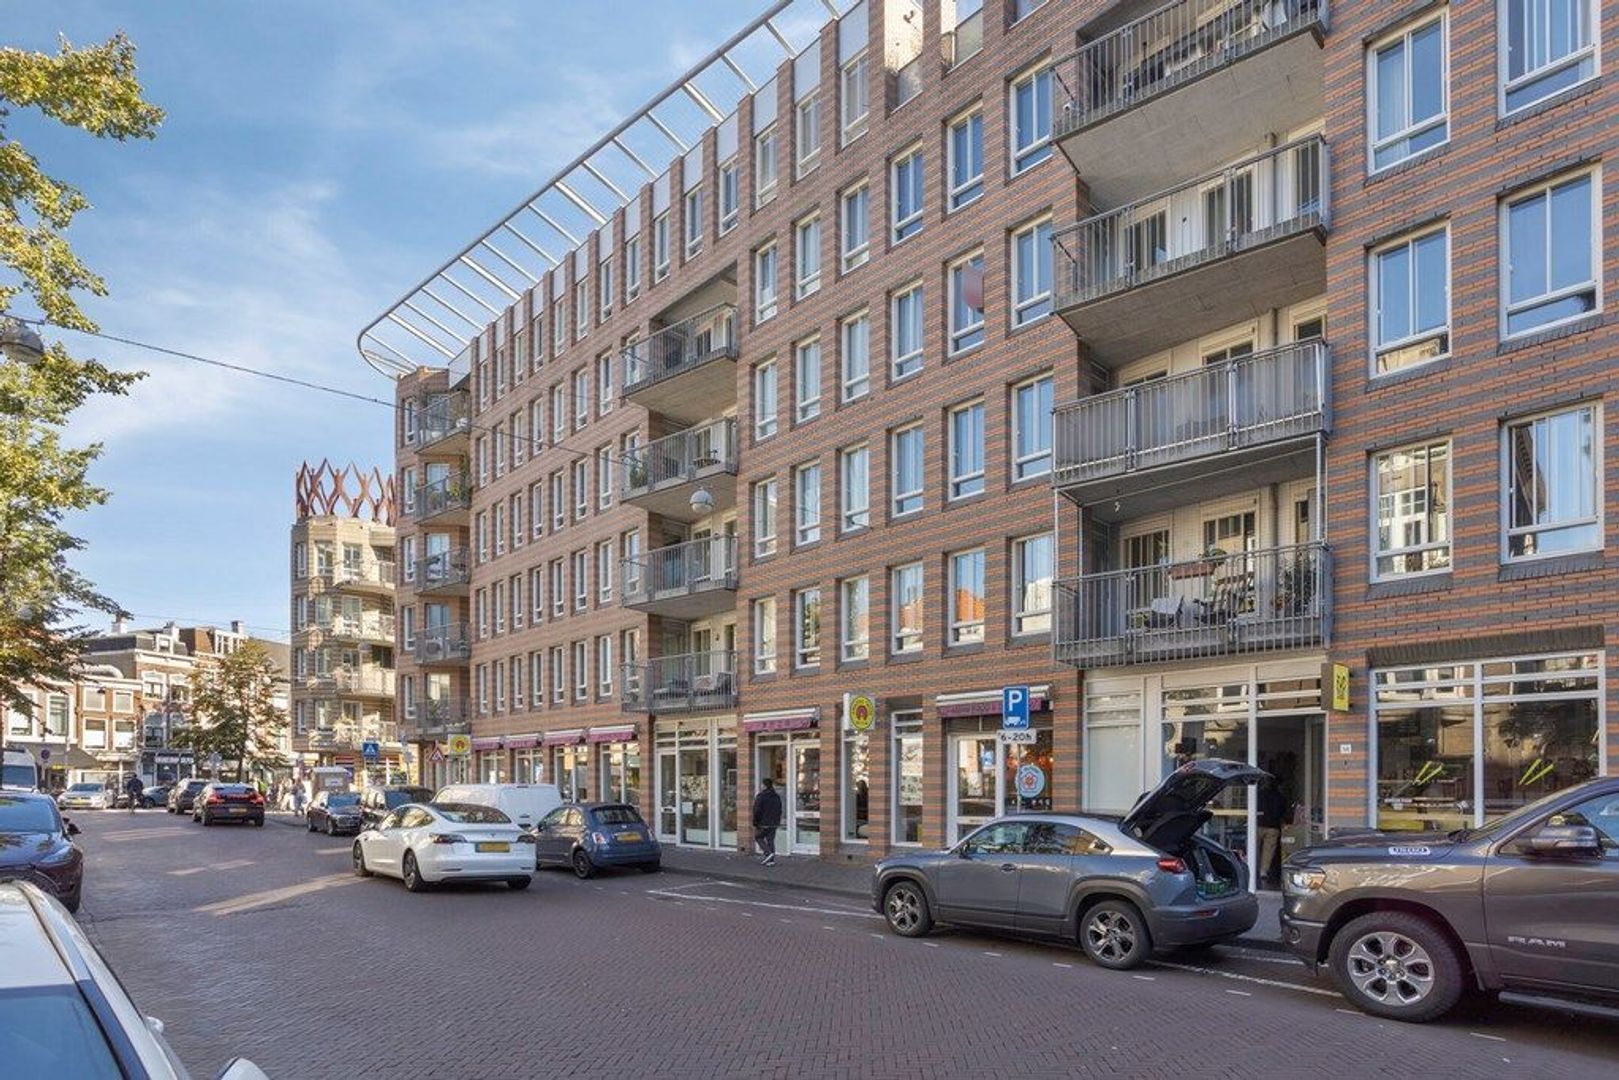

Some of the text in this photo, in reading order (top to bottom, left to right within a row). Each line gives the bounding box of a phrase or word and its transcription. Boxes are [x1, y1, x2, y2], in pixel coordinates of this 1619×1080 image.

[1008, 690, 1022, 711] P
[1001, 732, 1032, 742] 6-20h
[1507, 935, 1566, 948] RAM
